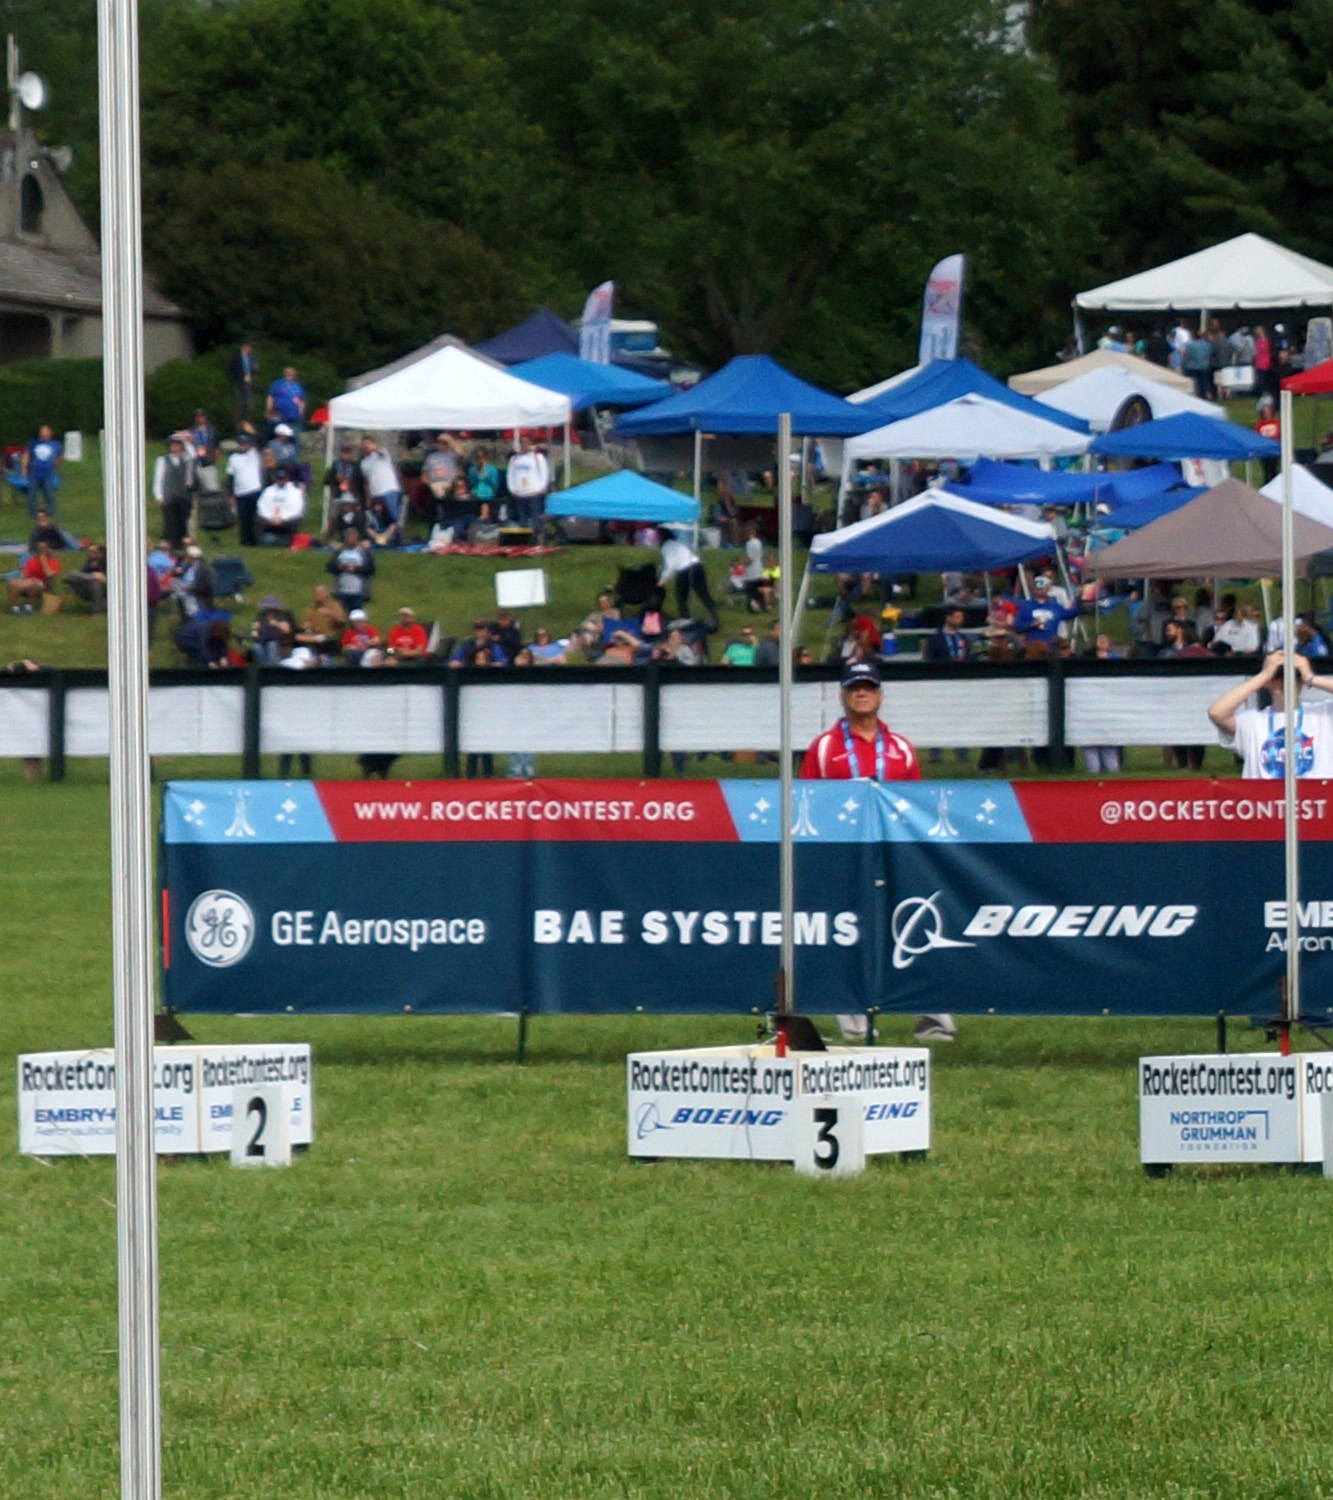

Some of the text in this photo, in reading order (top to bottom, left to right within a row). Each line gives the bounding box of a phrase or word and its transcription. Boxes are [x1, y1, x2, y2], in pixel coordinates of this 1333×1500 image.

[354, 800, 695, 822] WWW.ROCKETCONTEST.ORG
[271, 910, 486, 952] GE Aerospace
[533, 909, 860, 946] BAE SYSTEMS
[962, 904, 1198, 938] BOEING
[630, 1059, 794, 1100] RocketContest.org
[802, 1057, 927, 1095] RocketContest.org
[1142, 1061, 1296, 1101] RocketContest.org
[246, 1096, 267, 1157] 2
[671, 1107, 783, 1127] BOEING
[863, 1101, 919, 1121] EING
[1169, 1110, 1247, 1126] NORTHROP
[812, 1107, 840, 1170] 3
[1181, 1126, 1257, 1141] GRUMMAN
